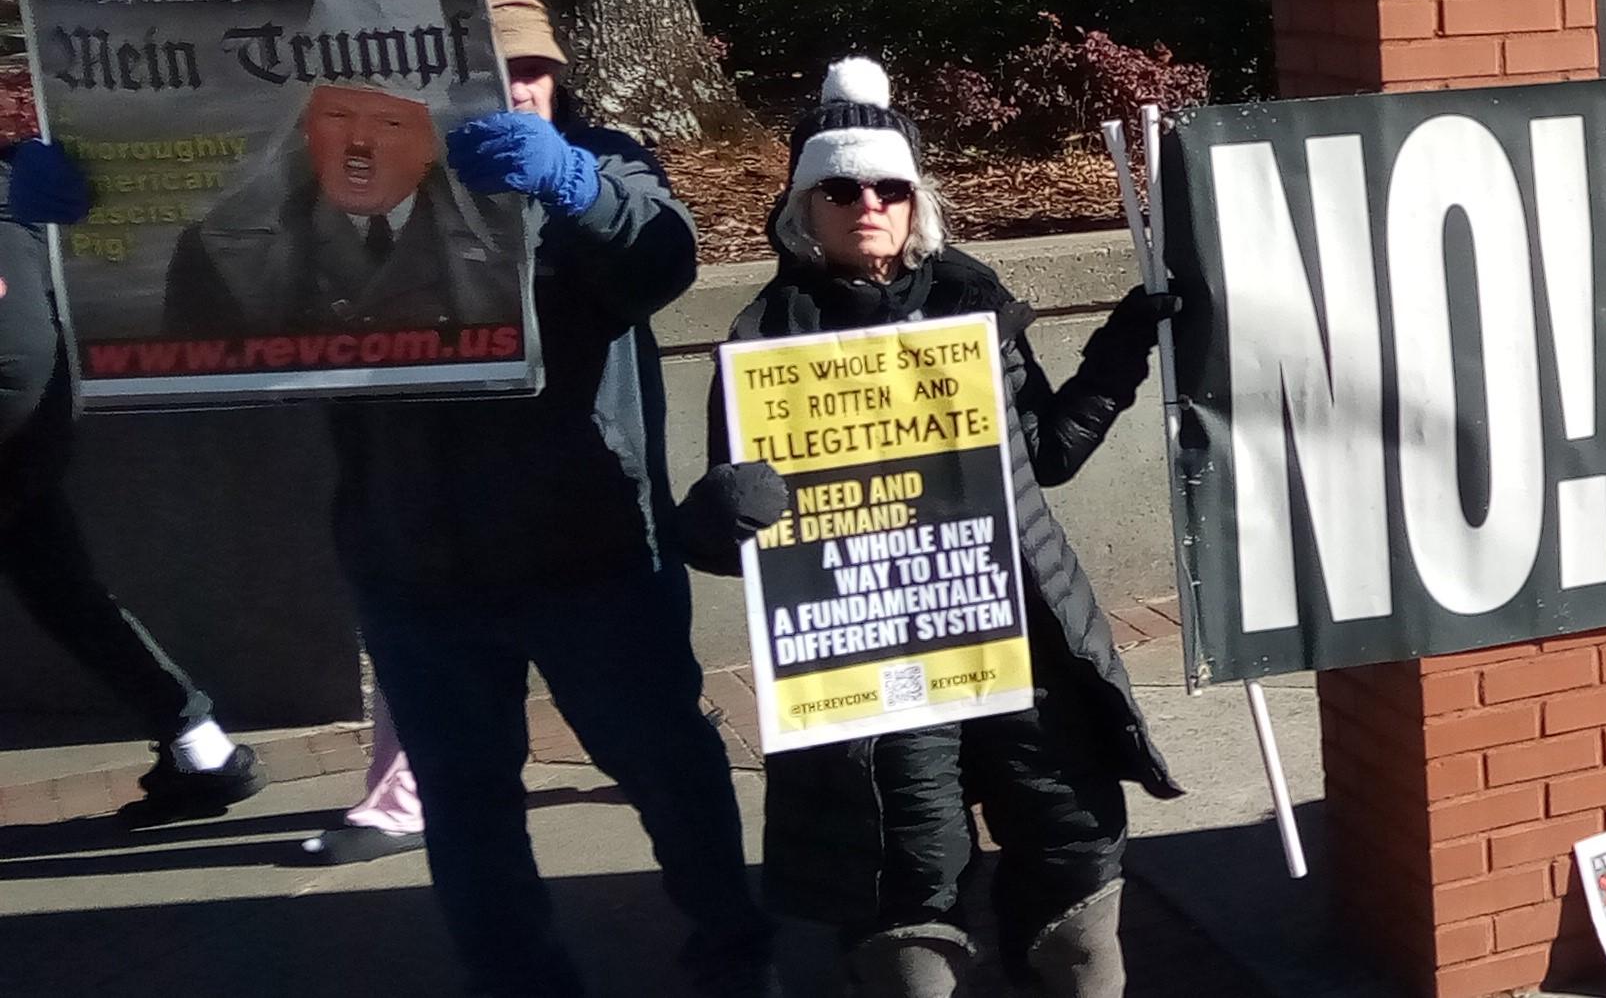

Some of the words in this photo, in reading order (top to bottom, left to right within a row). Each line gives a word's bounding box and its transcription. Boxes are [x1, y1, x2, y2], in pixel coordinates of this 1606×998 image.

[222, 12, 470, 84] Trumpf
[85, 324, 518, 374] www.revcom.us
[744, 364, 799, 389] THIS
[810, 353, 887, 381] WHOLE
[897, 342, 981, 370] SYSTEM
[765, 400, 789, 420] IS
[809, 386, 892, 419] ROTTEN
[914, 378, 959, 401] AND
[753, 408, 990, 464] ILLEGITIMATE:
[796, 480, 863, 514] NEED
[870, 471, 923, 501] AND
[801, 503, 917, 542] DEMAND:
[822, 541, 841, 569] A
[846, 530, 937, 563] WHOLE
[942, 516, 994, 545] NEW
[834, 564, 891, 595] WAY
[898, 556, 933, 583] TO
[939, 546, 1000, 576] LIVE,
[774, 608, 794, 636] A
[799, 571, 1008, 632] FUNDAMENTALLY
[775, 618, 910, 667] DIFFERENT
[917, 600, 1013, 642] SYSTEM
